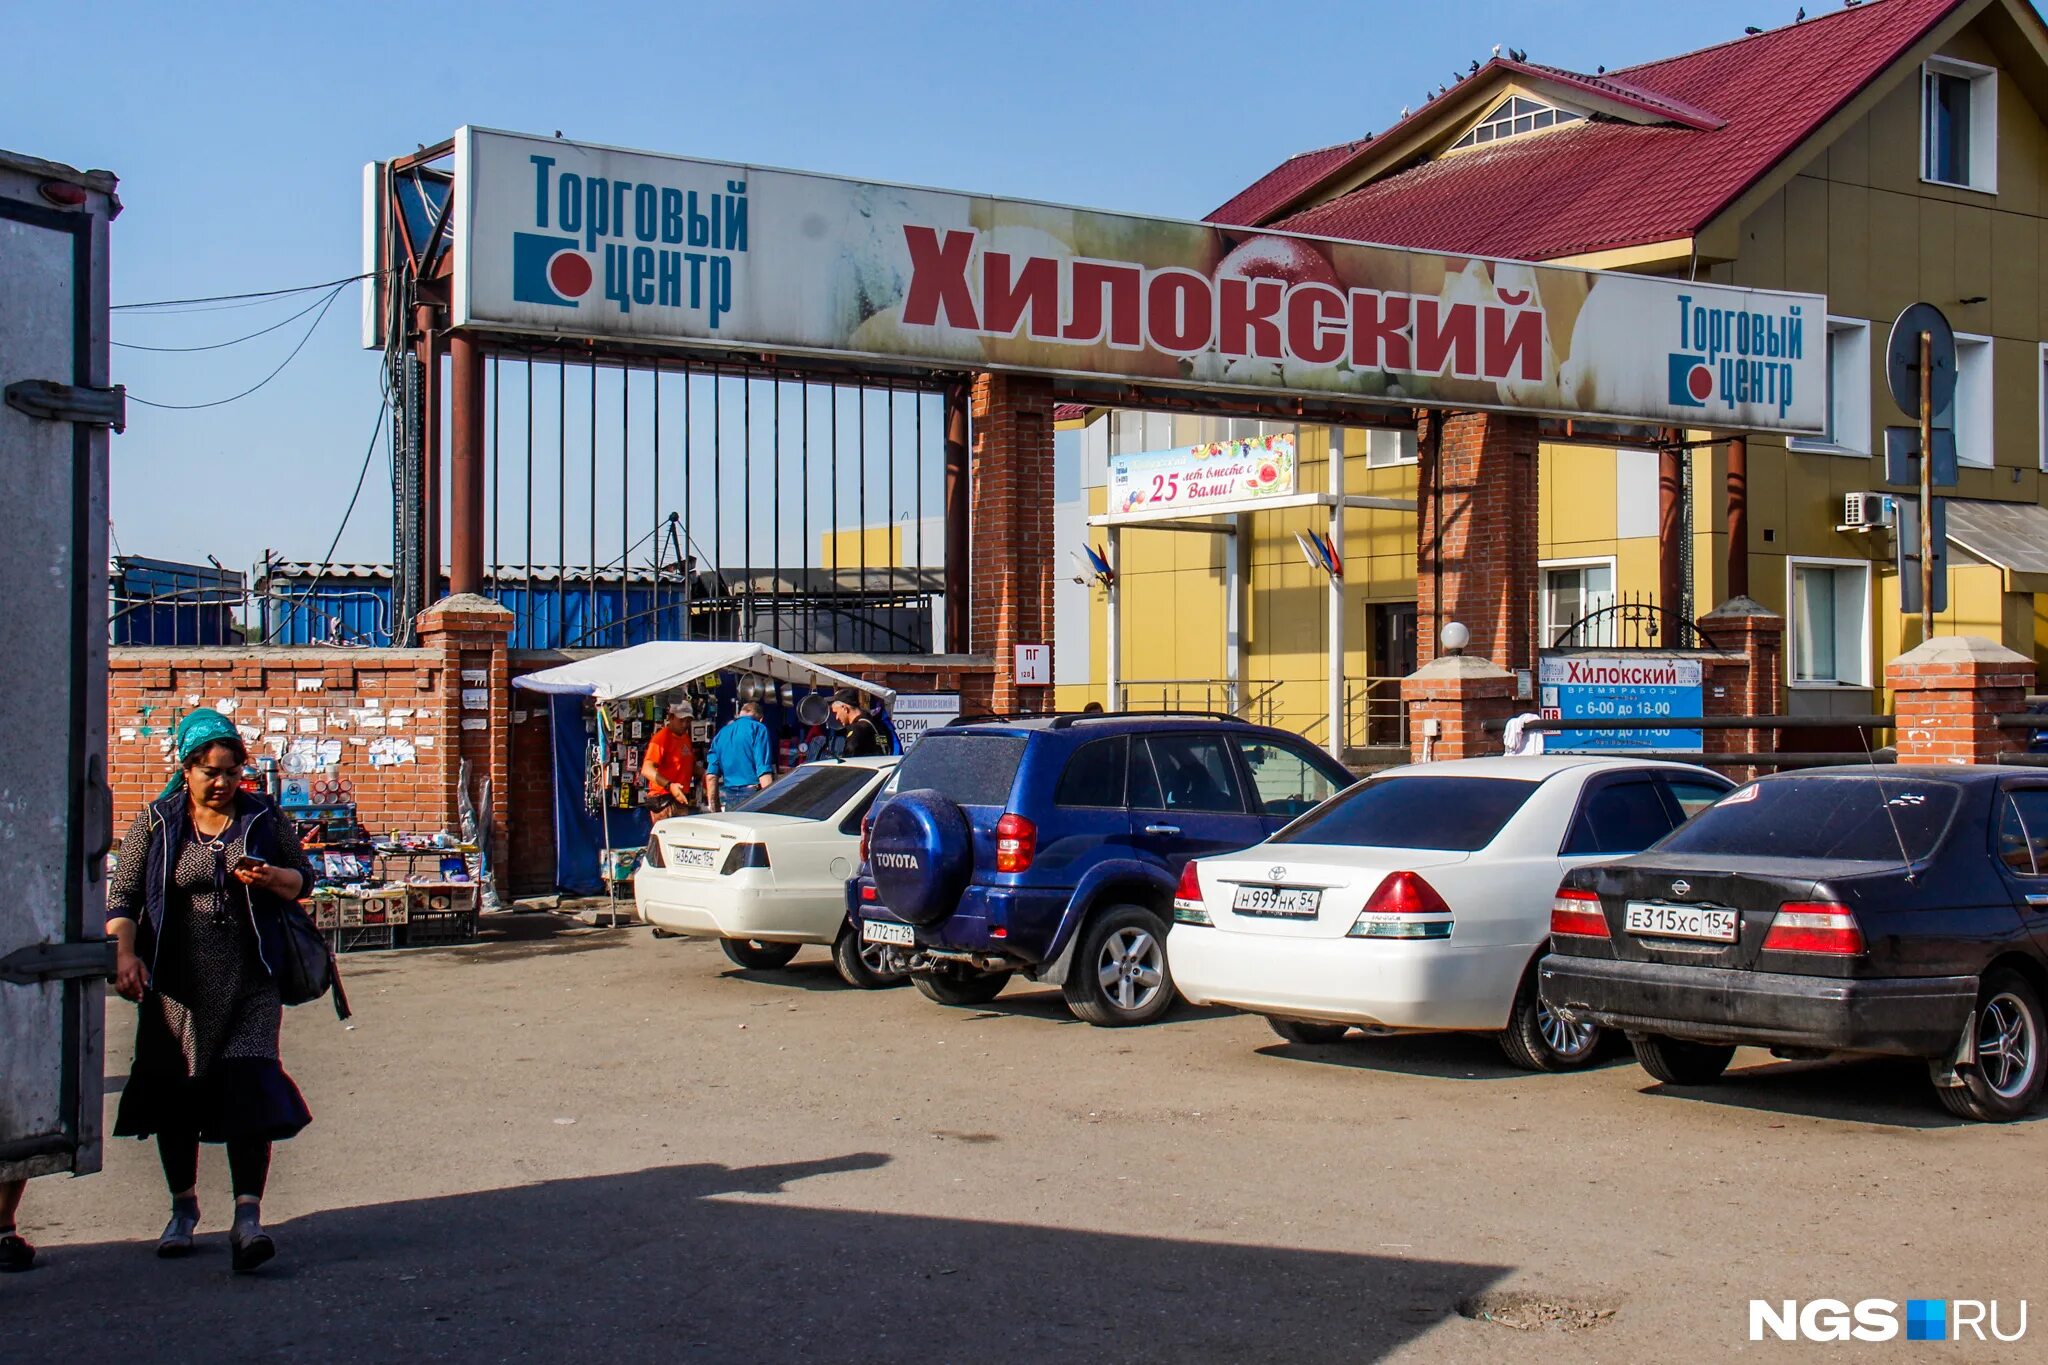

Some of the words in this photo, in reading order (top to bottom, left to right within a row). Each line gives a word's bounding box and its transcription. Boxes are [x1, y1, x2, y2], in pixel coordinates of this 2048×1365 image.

[530, 155, 749, 252] Торговый
[605, 243, 733, 329] центр
[902, 224, 1544, 382] Хилокский
[1677, 294, 1803, 360] Торговый
[1718, 354, 1794, 419] центр
[1149, 473, 1180, 503] 25
[1182, 467, 1204, 482] лет
[1205, 463, 1245, 480] вместе
[1187, 478, 1235, 499] Вами!
[1025, 648, 1040, 661] ПГ
[1567, 661, 1677, 685] Хилокский
[1567, 687, 1617, 695] ВРЕМЯ
[1621, 687, 1677, 696] РАБОТЫ
[1587, 702, 1615, 715] 6-00
[1617, 703, 1633, 717] до
[875, 852, 919, 870] TOYOTA
[1240, 890, 1296, 911] Н999НК
[1299, 892, 1314, 907] 54
[901, 926, 911, 938] 29
[1631, 908, 1700, 933] Е315ХС
[1704, 912, 1731, 929] 154
